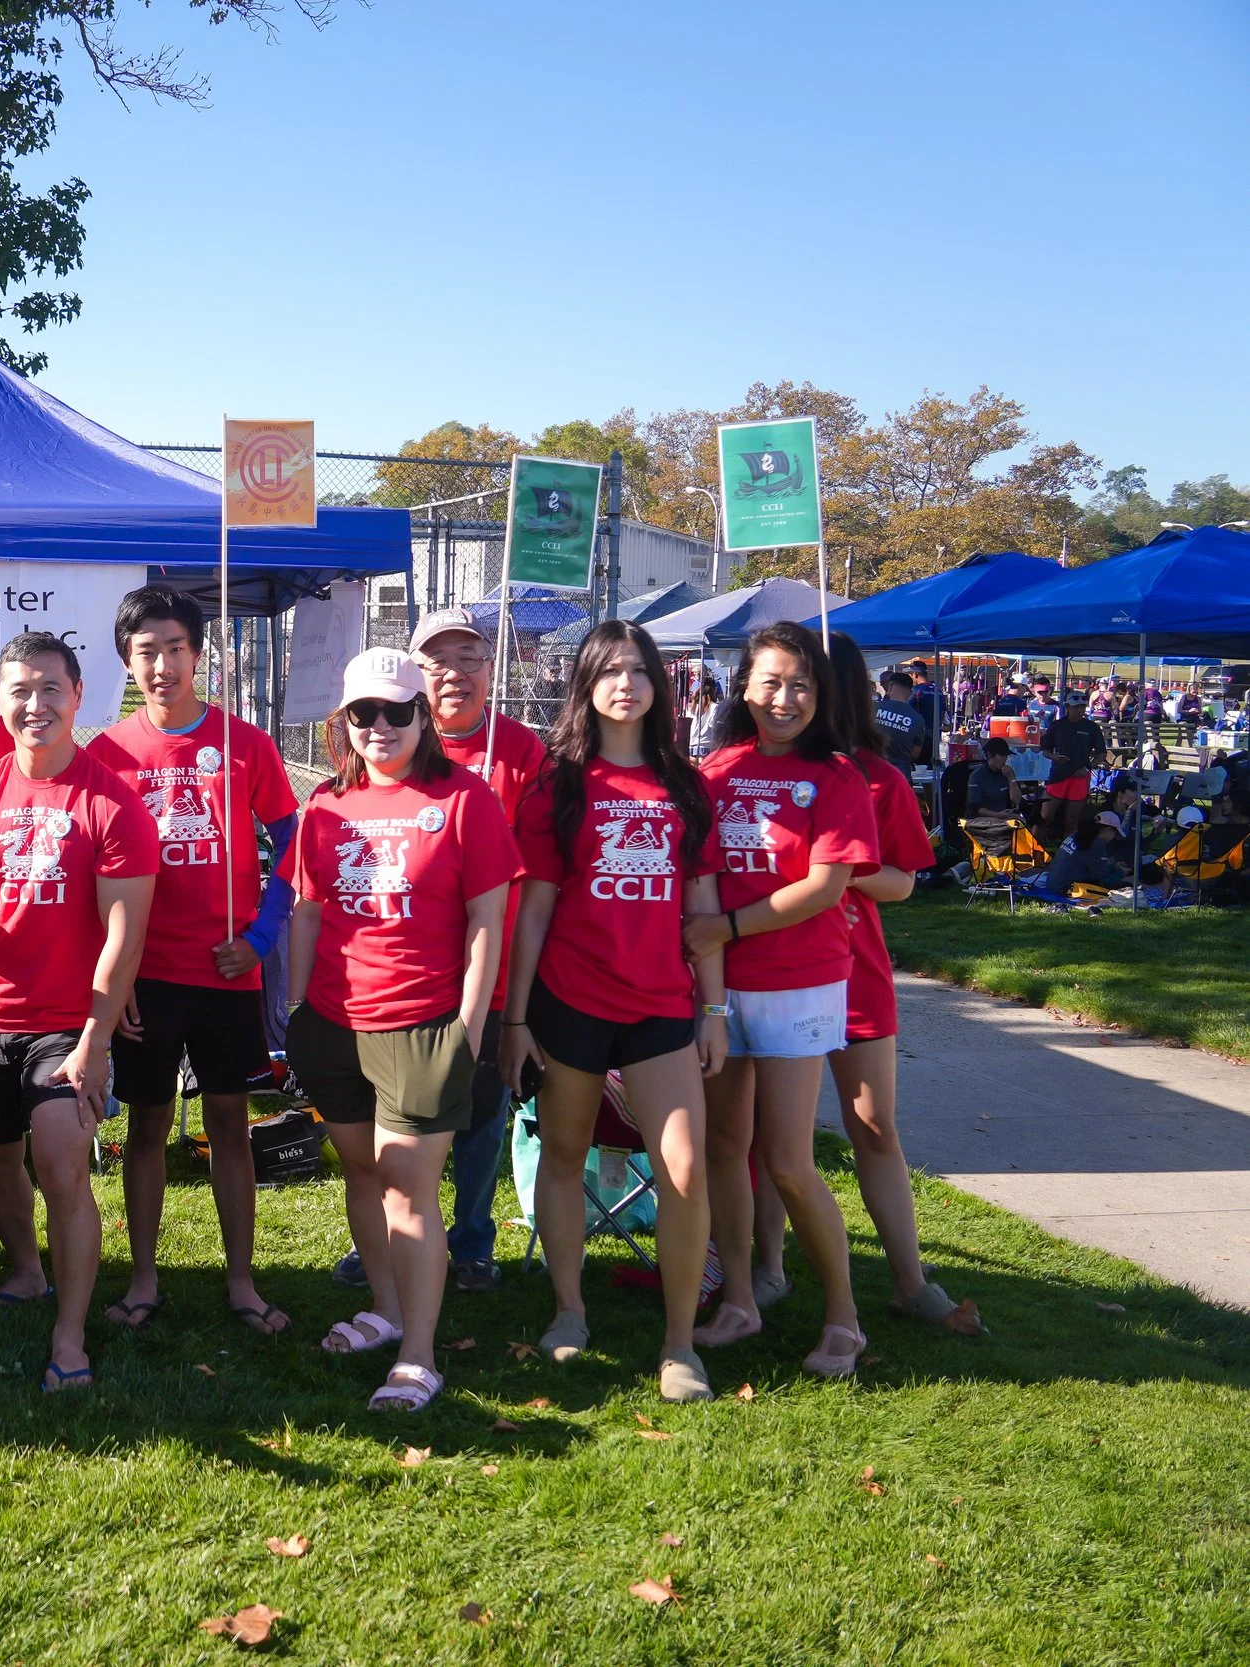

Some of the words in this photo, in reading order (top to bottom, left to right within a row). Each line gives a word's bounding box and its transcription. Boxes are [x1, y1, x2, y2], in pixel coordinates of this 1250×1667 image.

[761, 503, 784, 512] CCLI
[541, 541, 561, 550] CCLI
[876, 708, 912, 727] MUFG
[892, 723, 910, 733] BACK
[136, 767, 186, 780] DRAGON
[188, 767, 216, 776] BO
[150, 776, 204, 787] FESTIVAL
[727, 778, 770, 788] DRAGON
[770, 781, 796, 790] BOAT
[734, 788, 778, 796] FESTIVAL
[593, 800, 644, 810] DRAGON
[0, 806, 46, 818] DRAGON
[609, 809, 664, 818] FESTIVAL
[12, 816, 49, 826] FESTIV
[340, 819, 388, 829] DRAGON
[351, 828, 404, 838] FESTIVAL
[162, 842, 220, 866] CLI
[725, 850, 778, 874] CLI
[590, 876, 674, 901] CCLI
[338, 896, 414, 919] CCLI
[278, 1147, 304, 1160] bless
